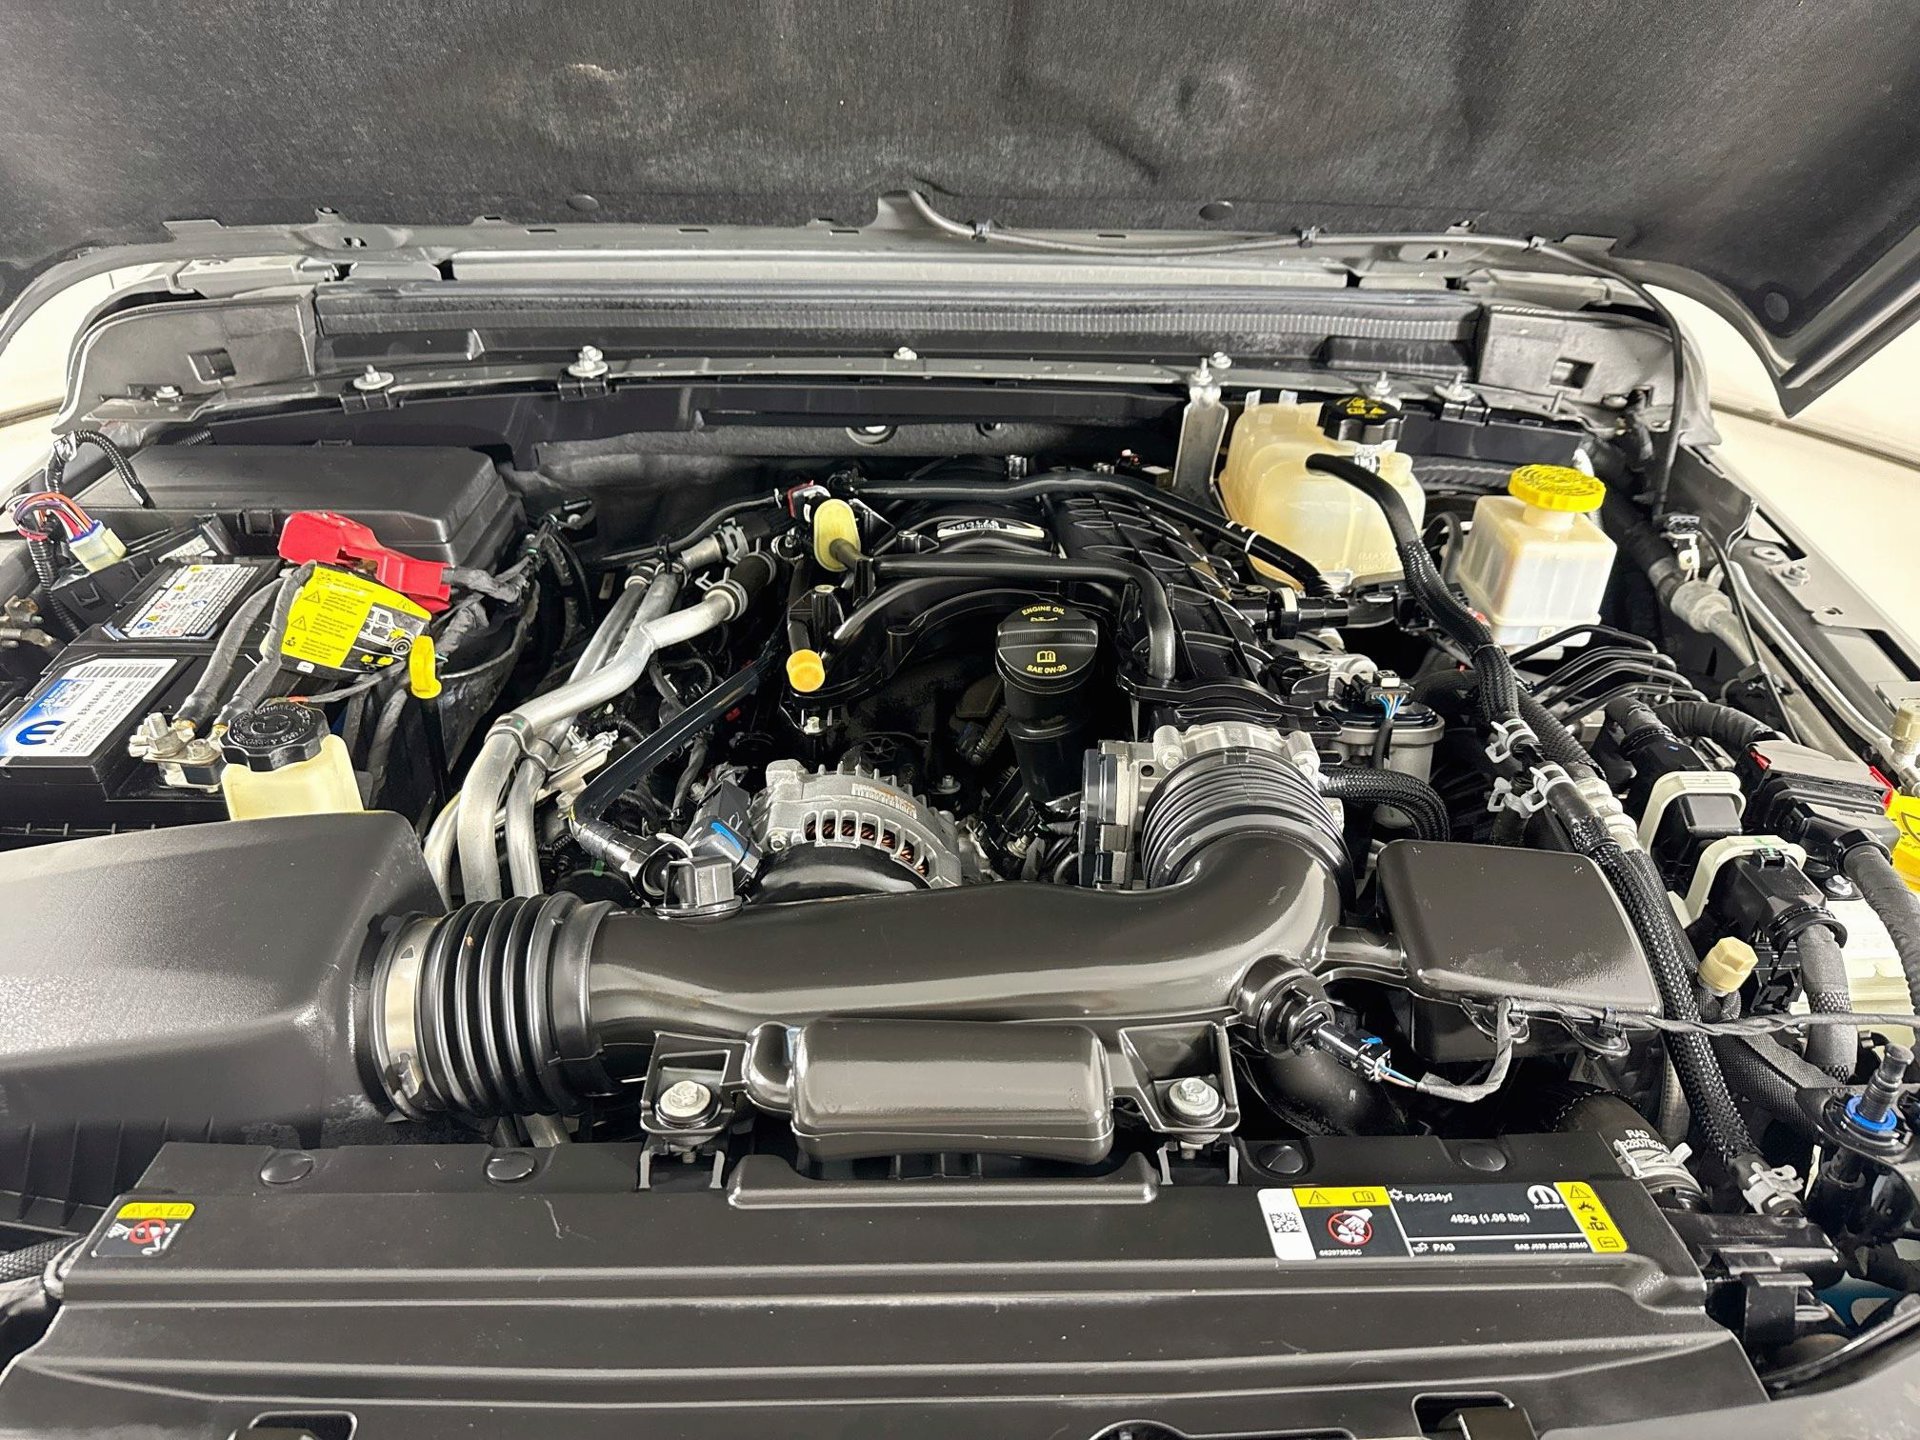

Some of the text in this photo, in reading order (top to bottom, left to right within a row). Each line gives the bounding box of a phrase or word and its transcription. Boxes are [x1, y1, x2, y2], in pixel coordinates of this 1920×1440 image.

[1022, 606, 1065, 615] ENGINE OIL
[1026, 664, 1067, 674] SAE 0W-20
[1624, 1129, 1650, 1139] RAD
